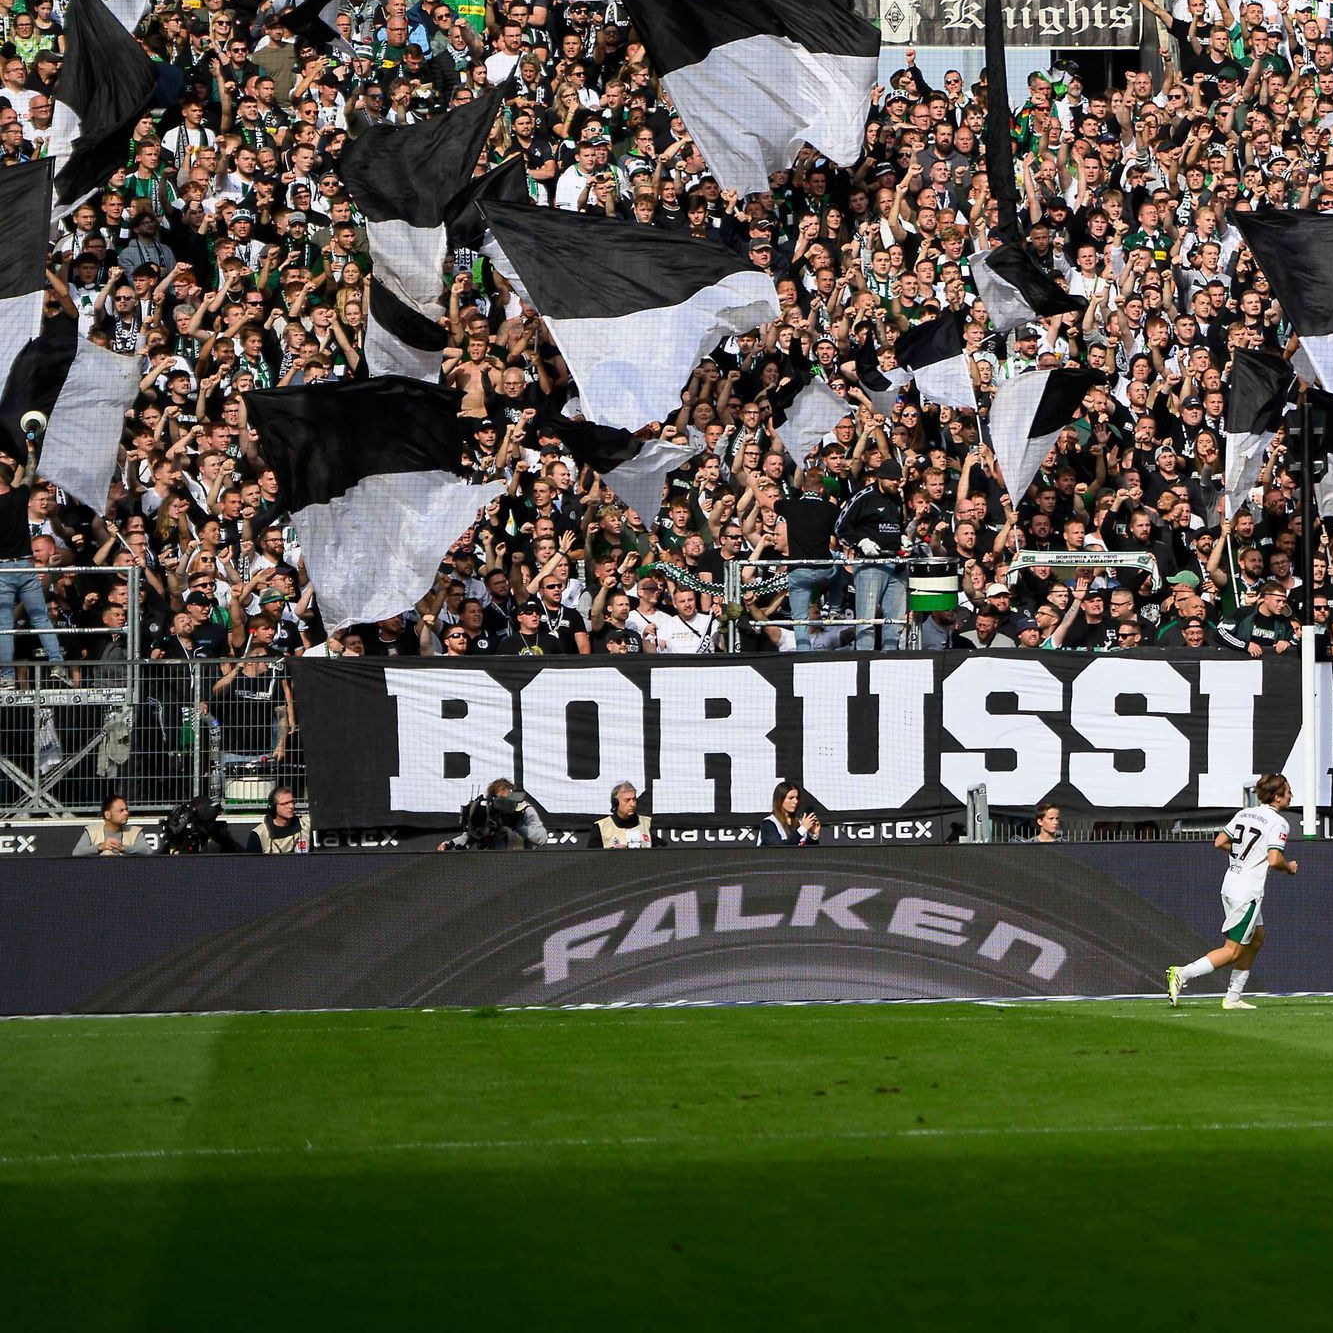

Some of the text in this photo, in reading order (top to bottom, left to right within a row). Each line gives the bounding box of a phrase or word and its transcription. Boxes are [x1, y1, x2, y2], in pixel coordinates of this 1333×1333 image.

[312, 829, 399, 847] latex
[1229, 823, 1263, 861] 27
[543, 884, 1066, 984] FALKEN
